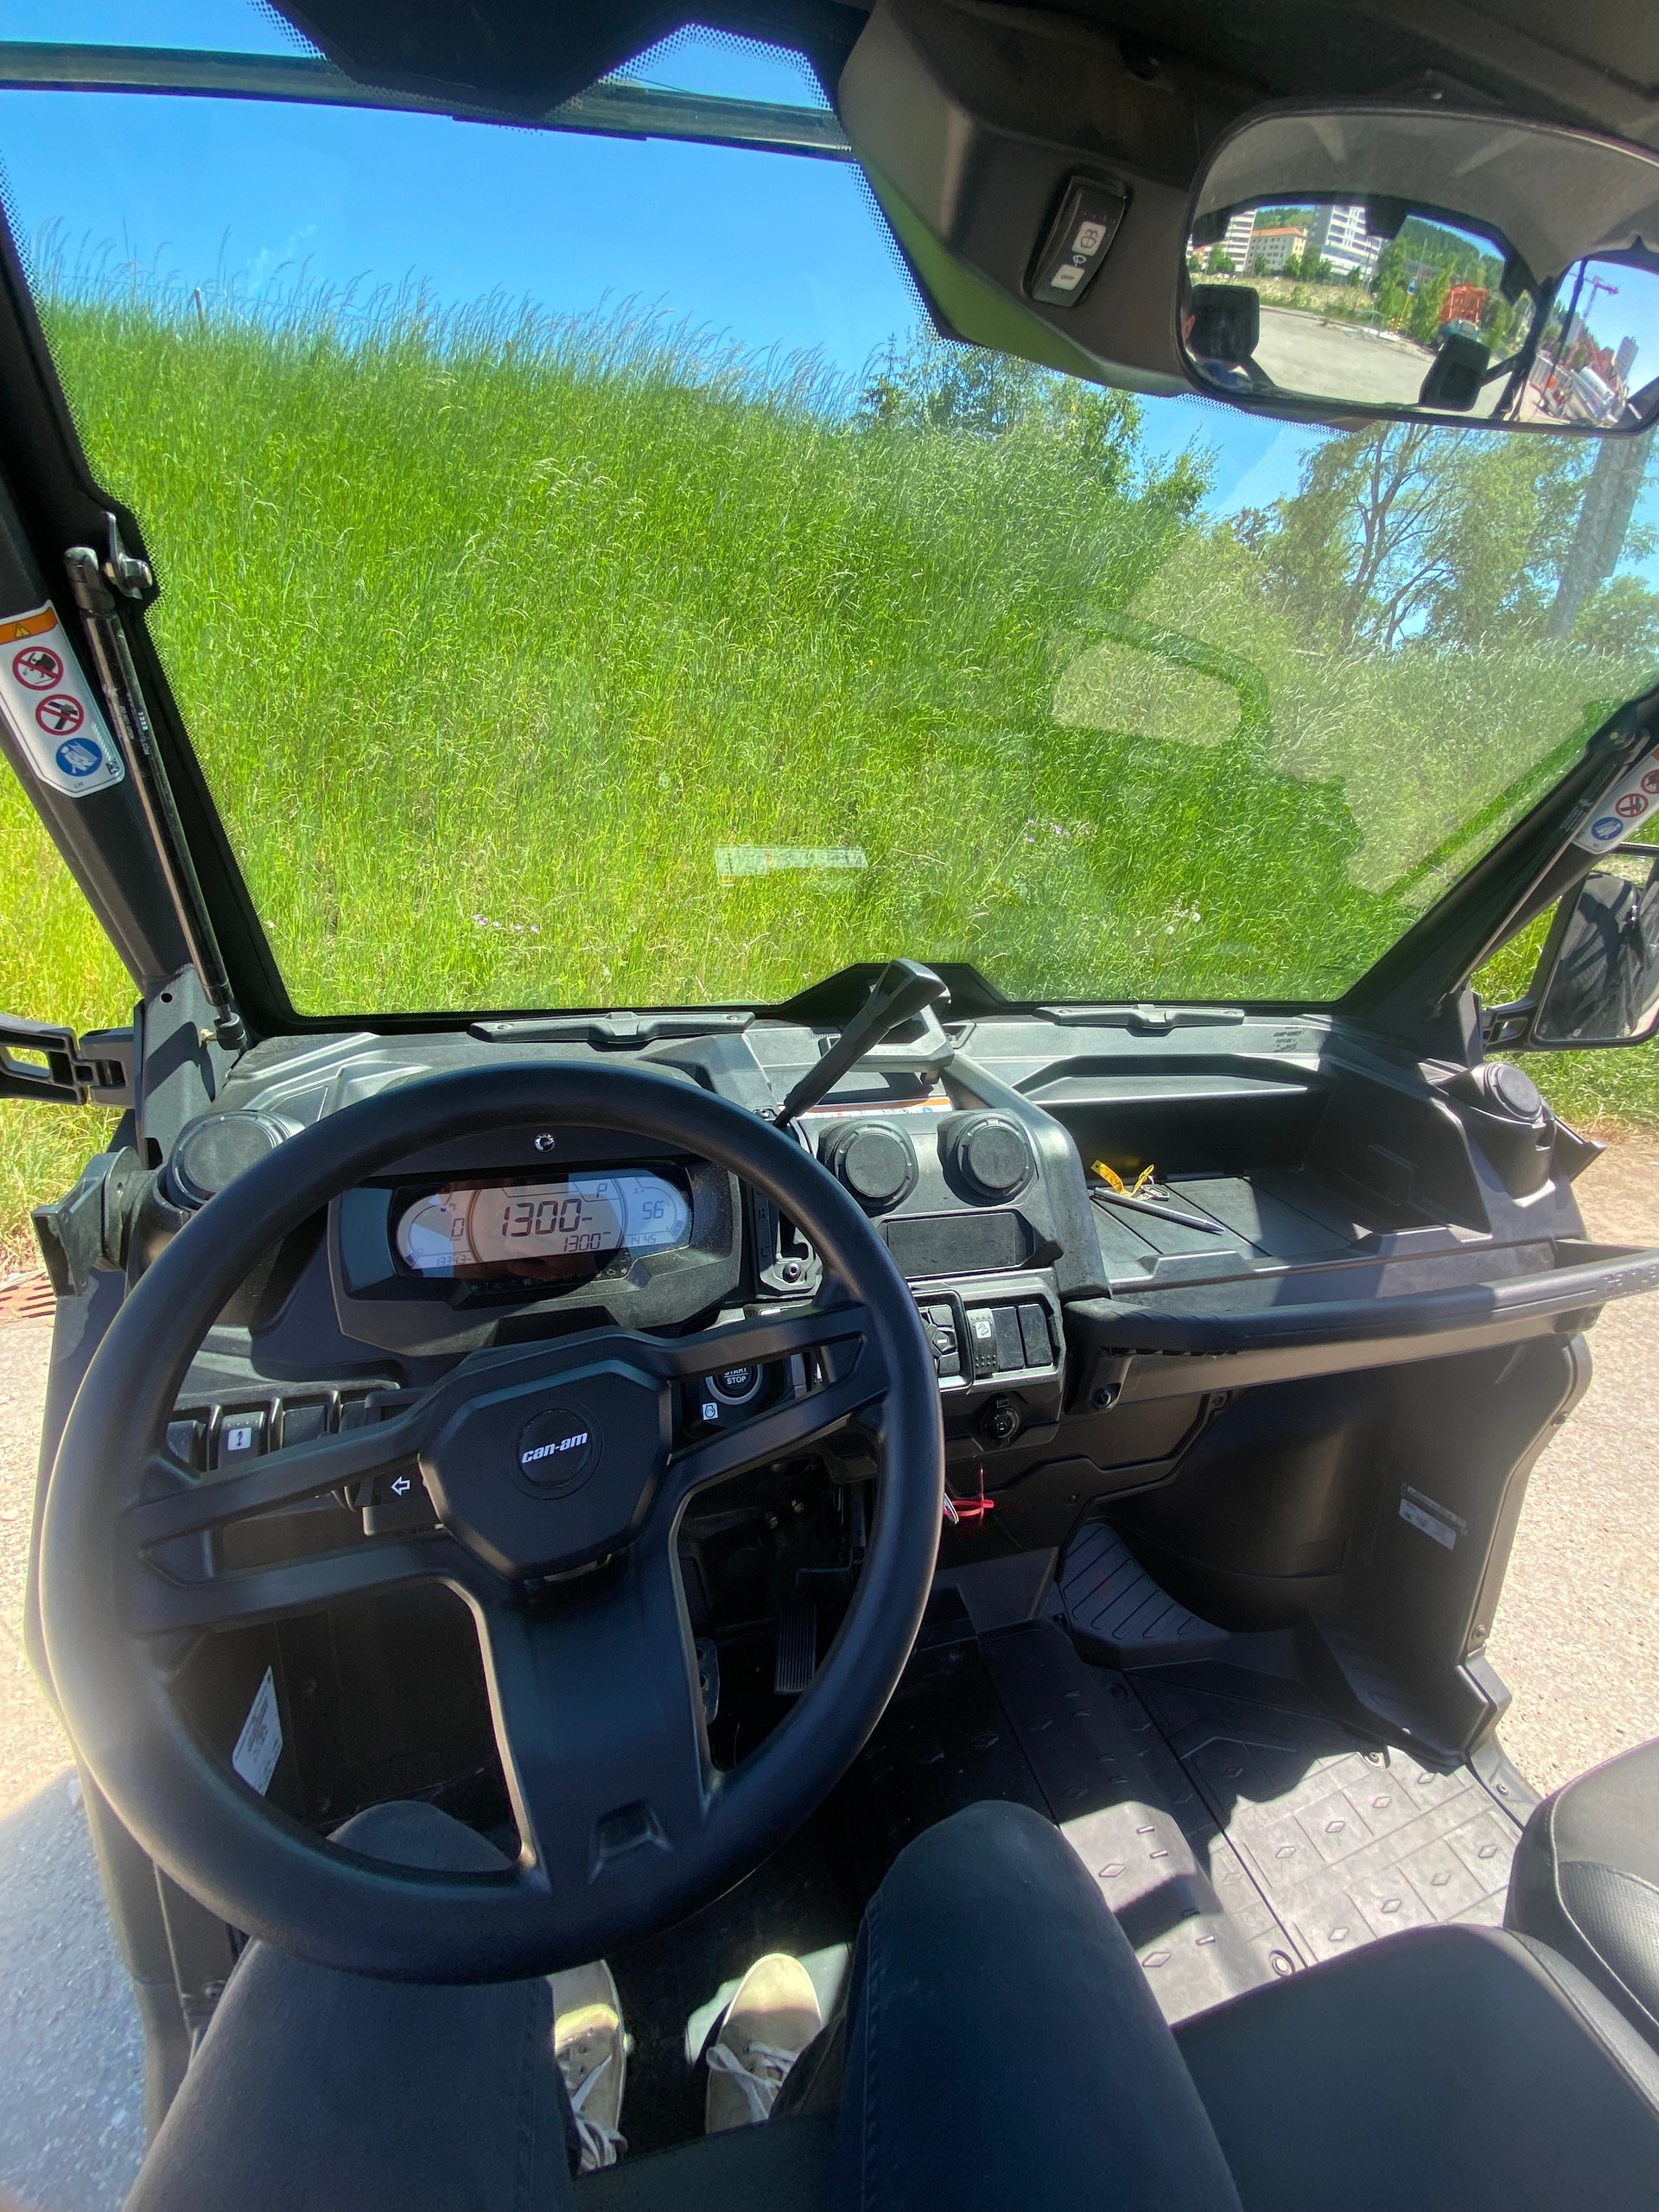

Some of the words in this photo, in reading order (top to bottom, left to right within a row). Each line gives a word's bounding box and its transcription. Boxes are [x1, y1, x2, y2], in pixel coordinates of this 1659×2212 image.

[596, 1182, 607, 1198] P
[501, 1198, 582, 1237] 1300
[642, 1200, 664, 1220] 56
[451, 1217, 465, 1237] 0
[563, 1233, 601, 1253] 1300
[727, 1375, 747, 1385] STOP
[521, 1432, 588, 1464] can-am
